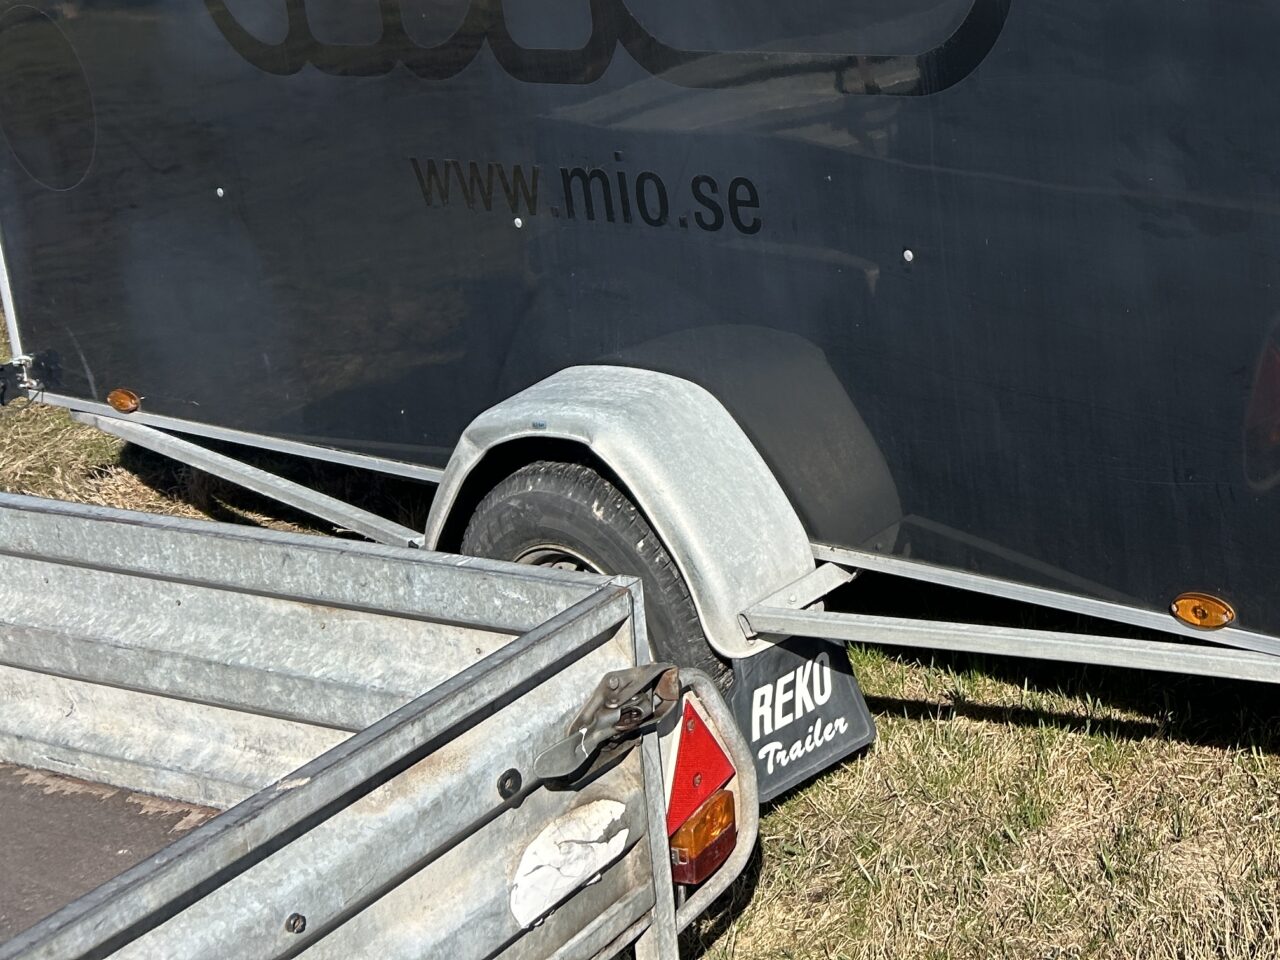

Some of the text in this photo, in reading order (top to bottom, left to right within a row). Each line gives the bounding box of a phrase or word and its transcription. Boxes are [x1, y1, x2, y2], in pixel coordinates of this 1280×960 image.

[408, 150, 763, 235] www.mio.se
[751, 651, 832, 743] REKO
[757, 716, 849, 775] Trailer
